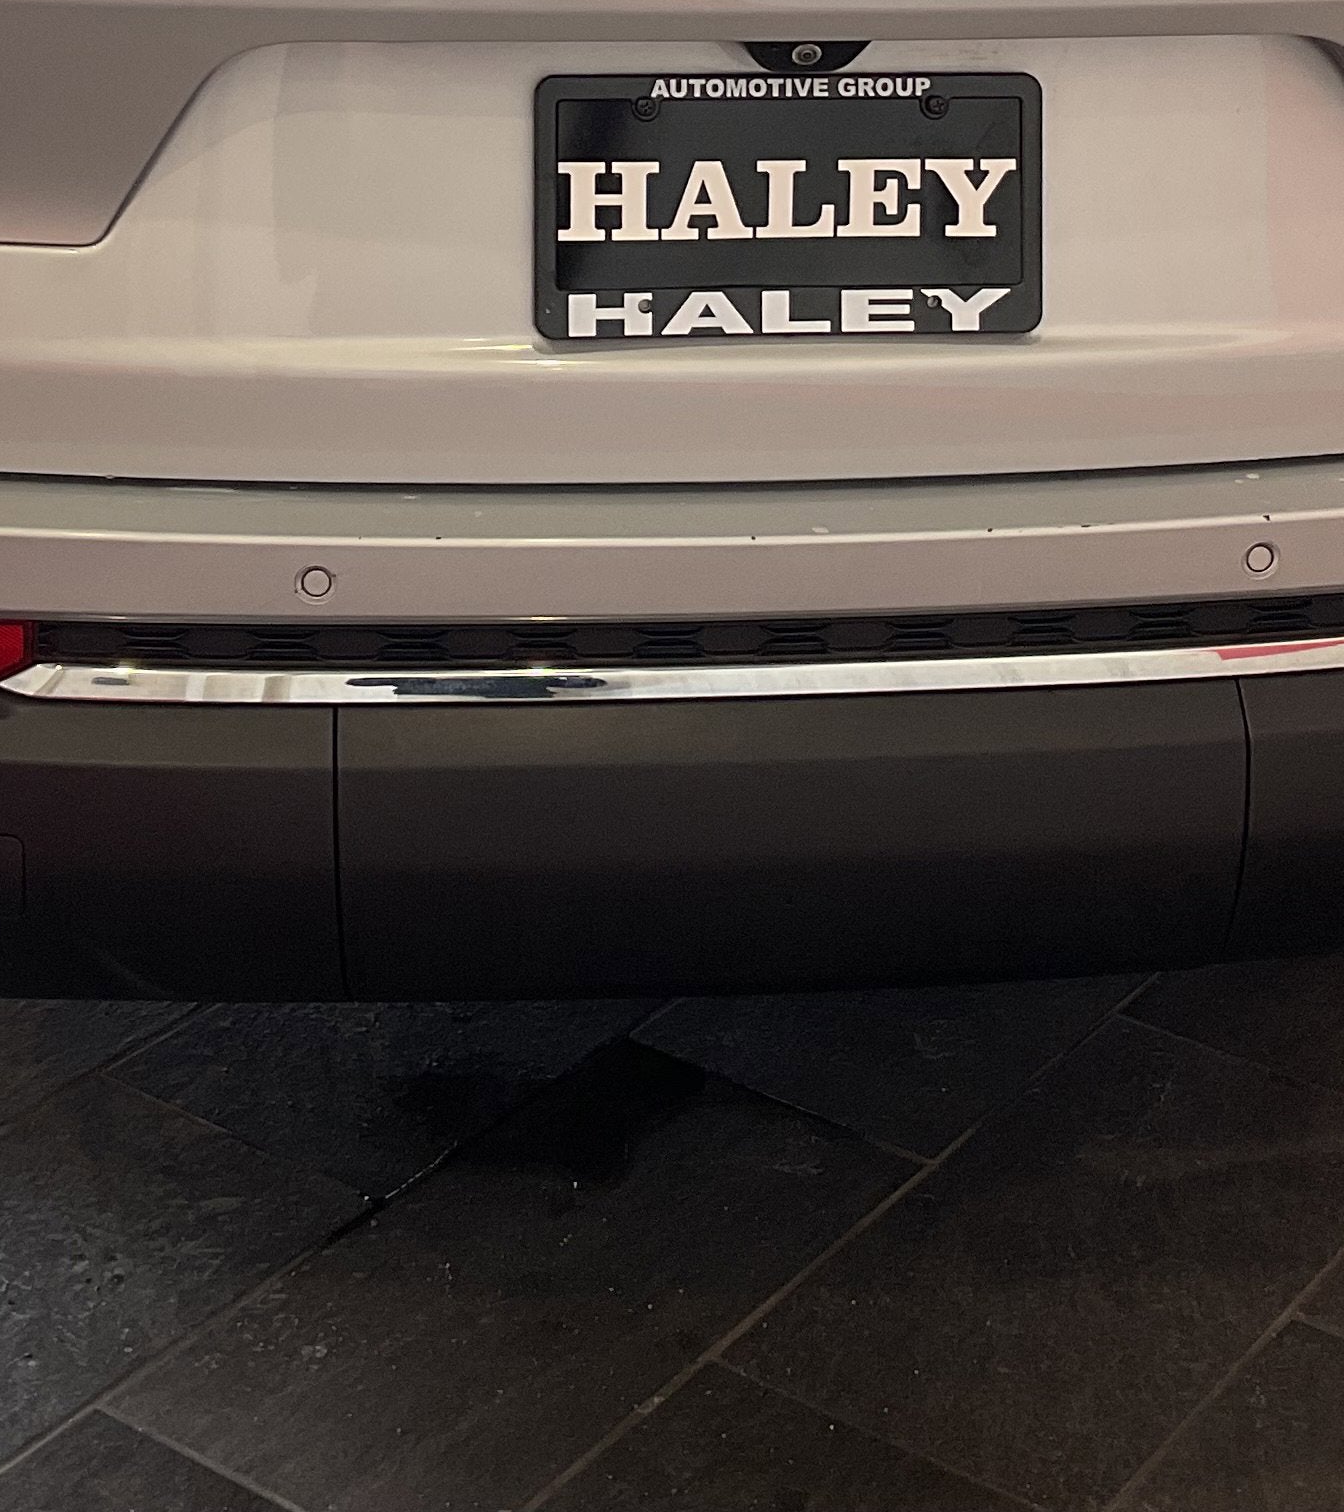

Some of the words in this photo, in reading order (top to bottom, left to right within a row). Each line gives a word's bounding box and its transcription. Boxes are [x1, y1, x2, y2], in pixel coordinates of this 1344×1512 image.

[650, 77, 830, 99] AUTOMOTIVE
[837, 76, 932, 98] GROUP
[557, 157, 1017, 242] HALEY
[567, 287, 1012, 338] HALEY
